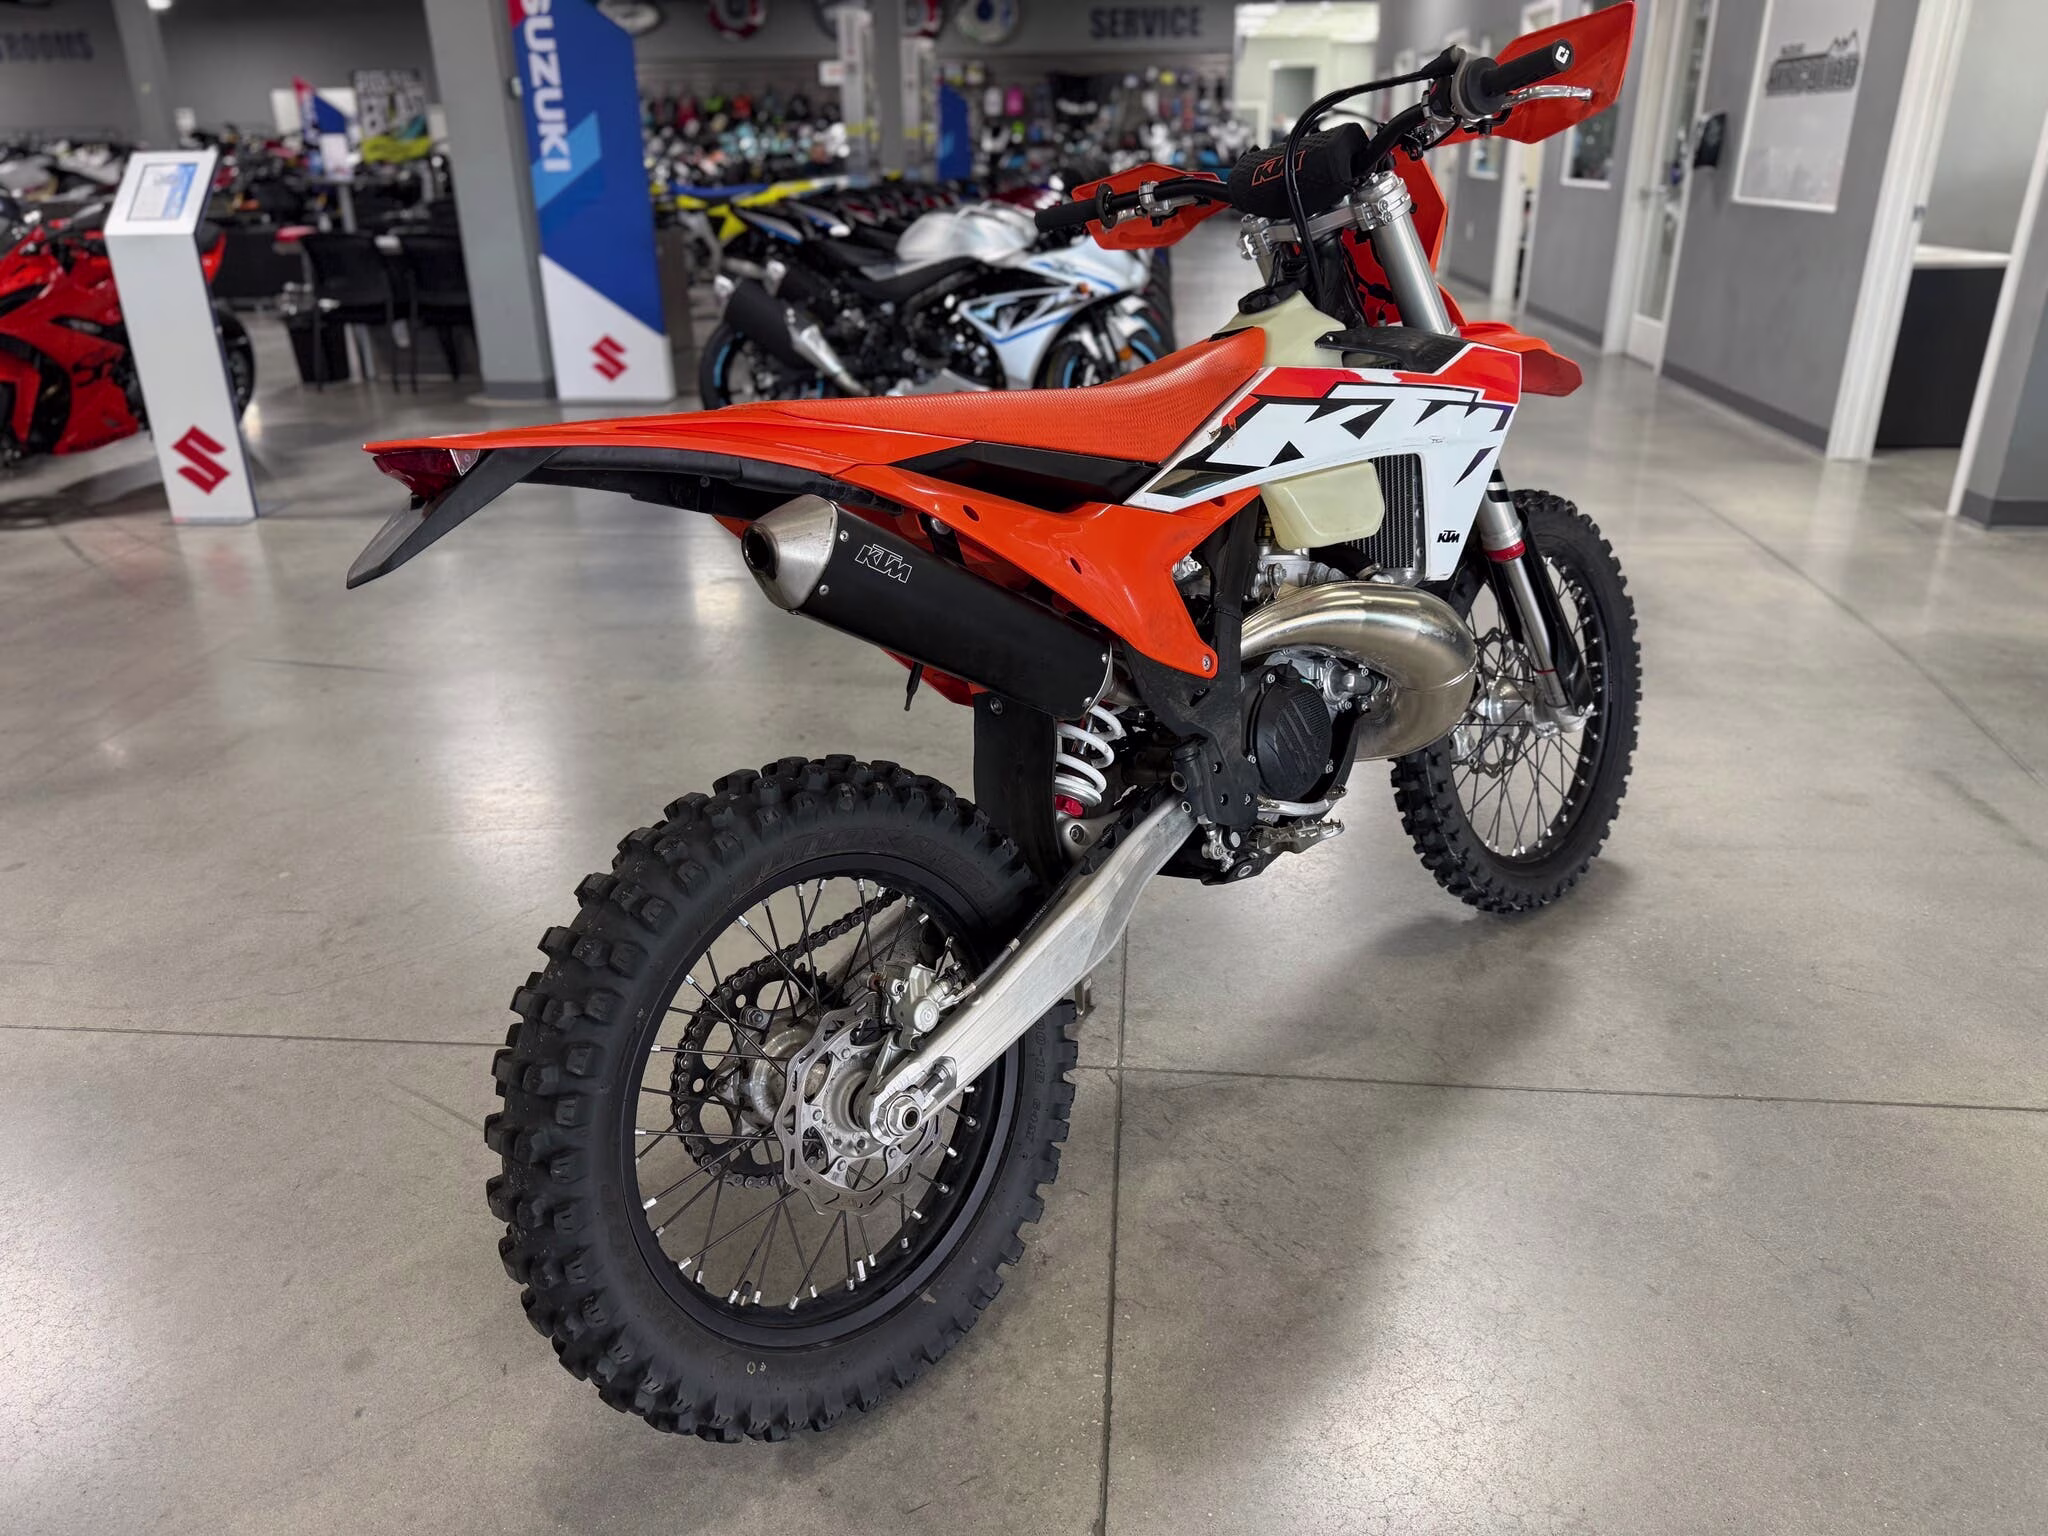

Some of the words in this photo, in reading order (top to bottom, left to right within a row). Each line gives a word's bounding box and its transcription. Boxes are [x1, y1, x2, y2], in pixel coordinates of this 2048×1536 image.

[1090, 7, 1201, 39] SERVICE
[1204, 383, 1512, 477] KTM
[1436, 529, 1460, 543] KTM
[854, 543, 913, 584] KTM
